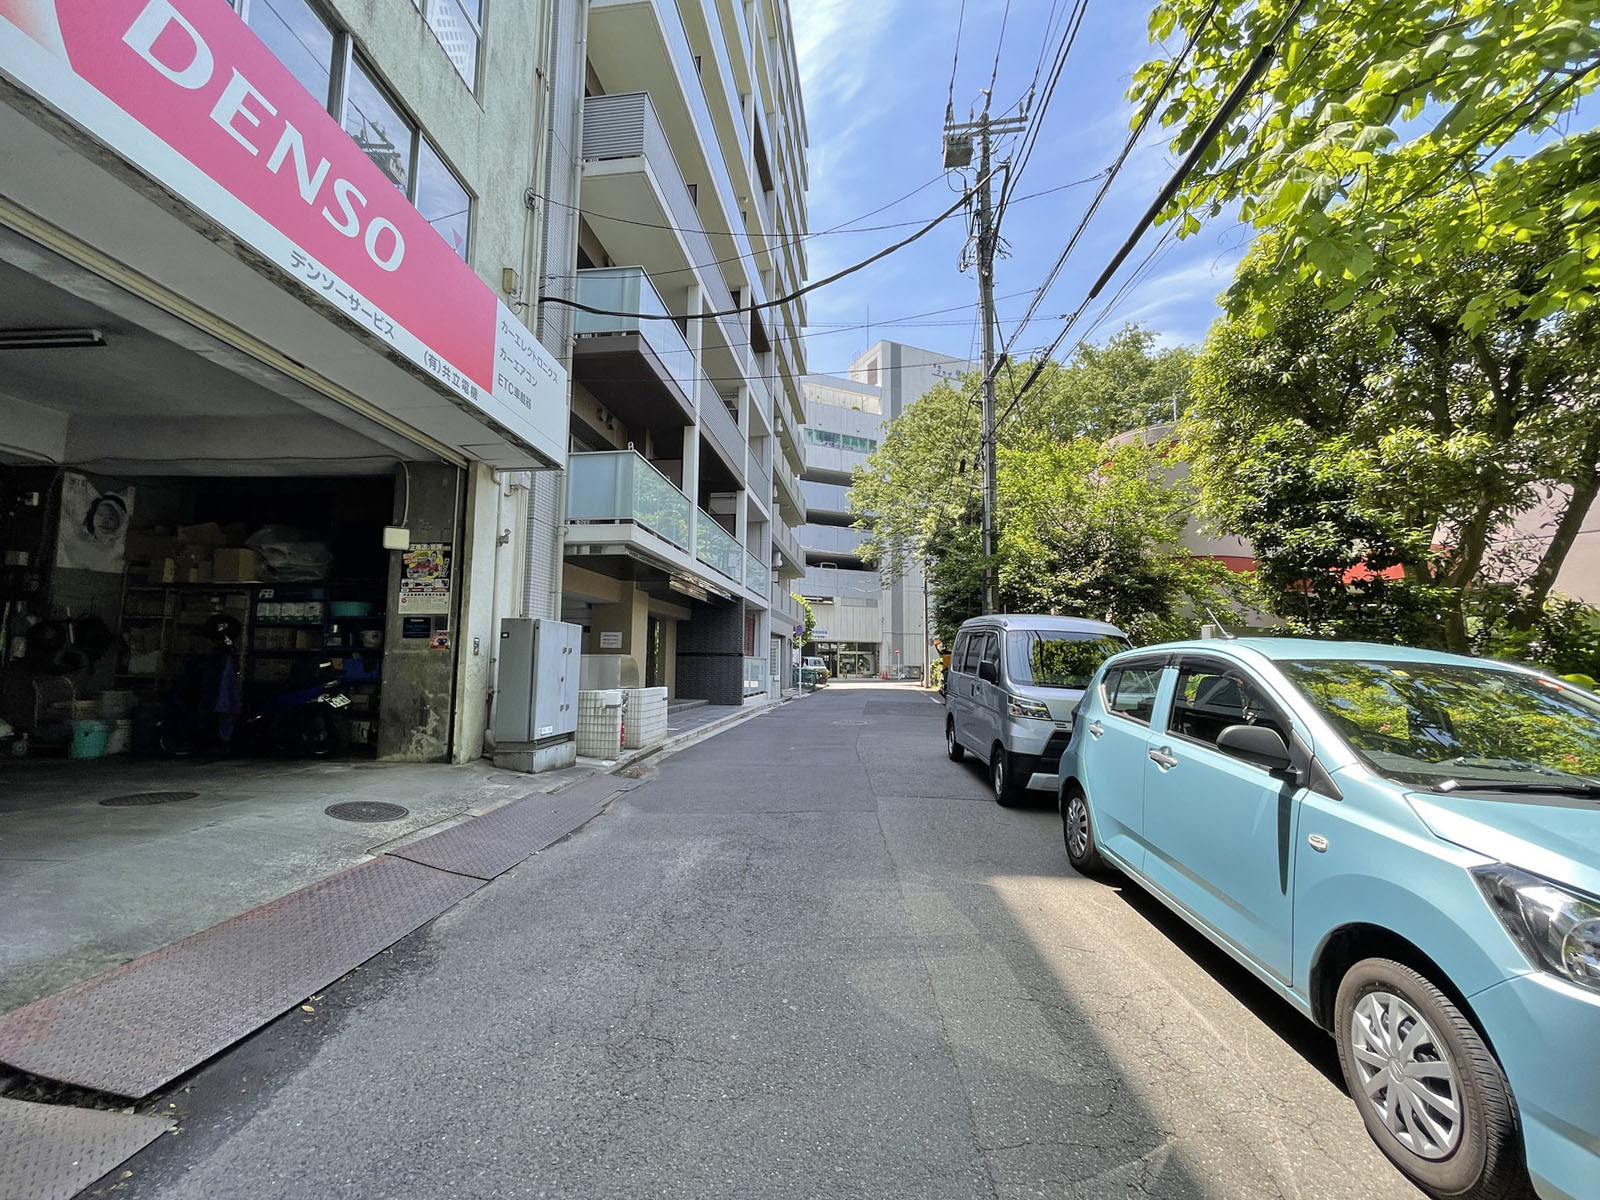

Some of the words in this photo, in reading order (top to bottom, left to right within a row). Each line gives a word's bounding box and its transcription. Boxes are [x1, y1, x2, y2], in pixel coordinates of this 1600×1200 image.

[122, 0, 405, 272] DENSO
[290, 250, 394, 340] デンソーサービス
[500, 348, 538, 387] カーエアコン
[501, 320, 558, 384] カーエレクトロニクス
[498, 373, 531, 410] ETC車載器
